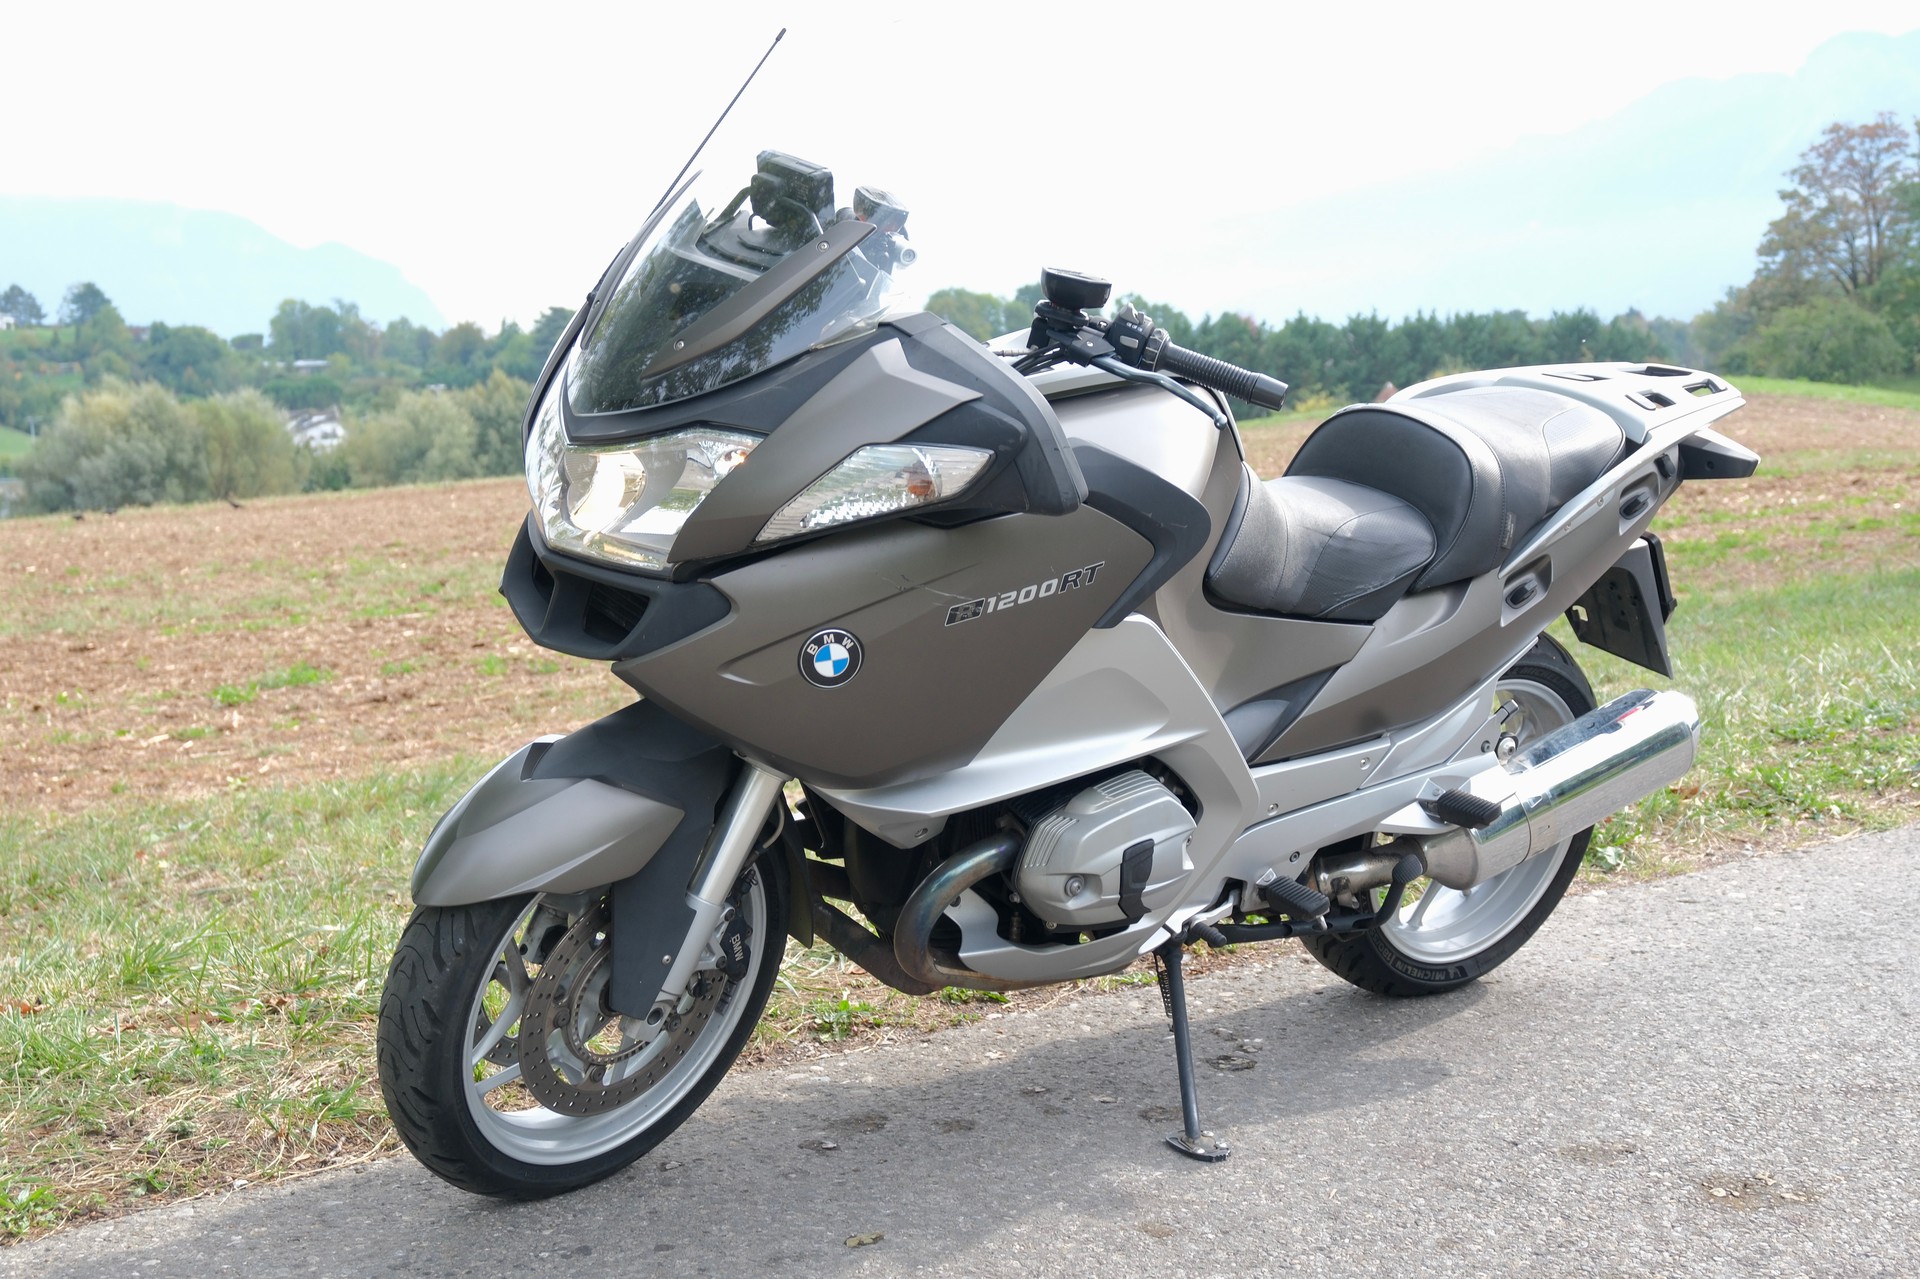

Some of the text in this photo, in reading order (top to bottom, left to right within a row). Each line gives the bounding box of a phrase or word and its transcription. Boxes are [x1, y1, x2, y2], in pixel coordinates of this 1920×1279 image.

[807, 633, 854, 656] BMW
[731, 933, 744, 961] BMW
[1395, 960, 1446, 980] MICHELIN
